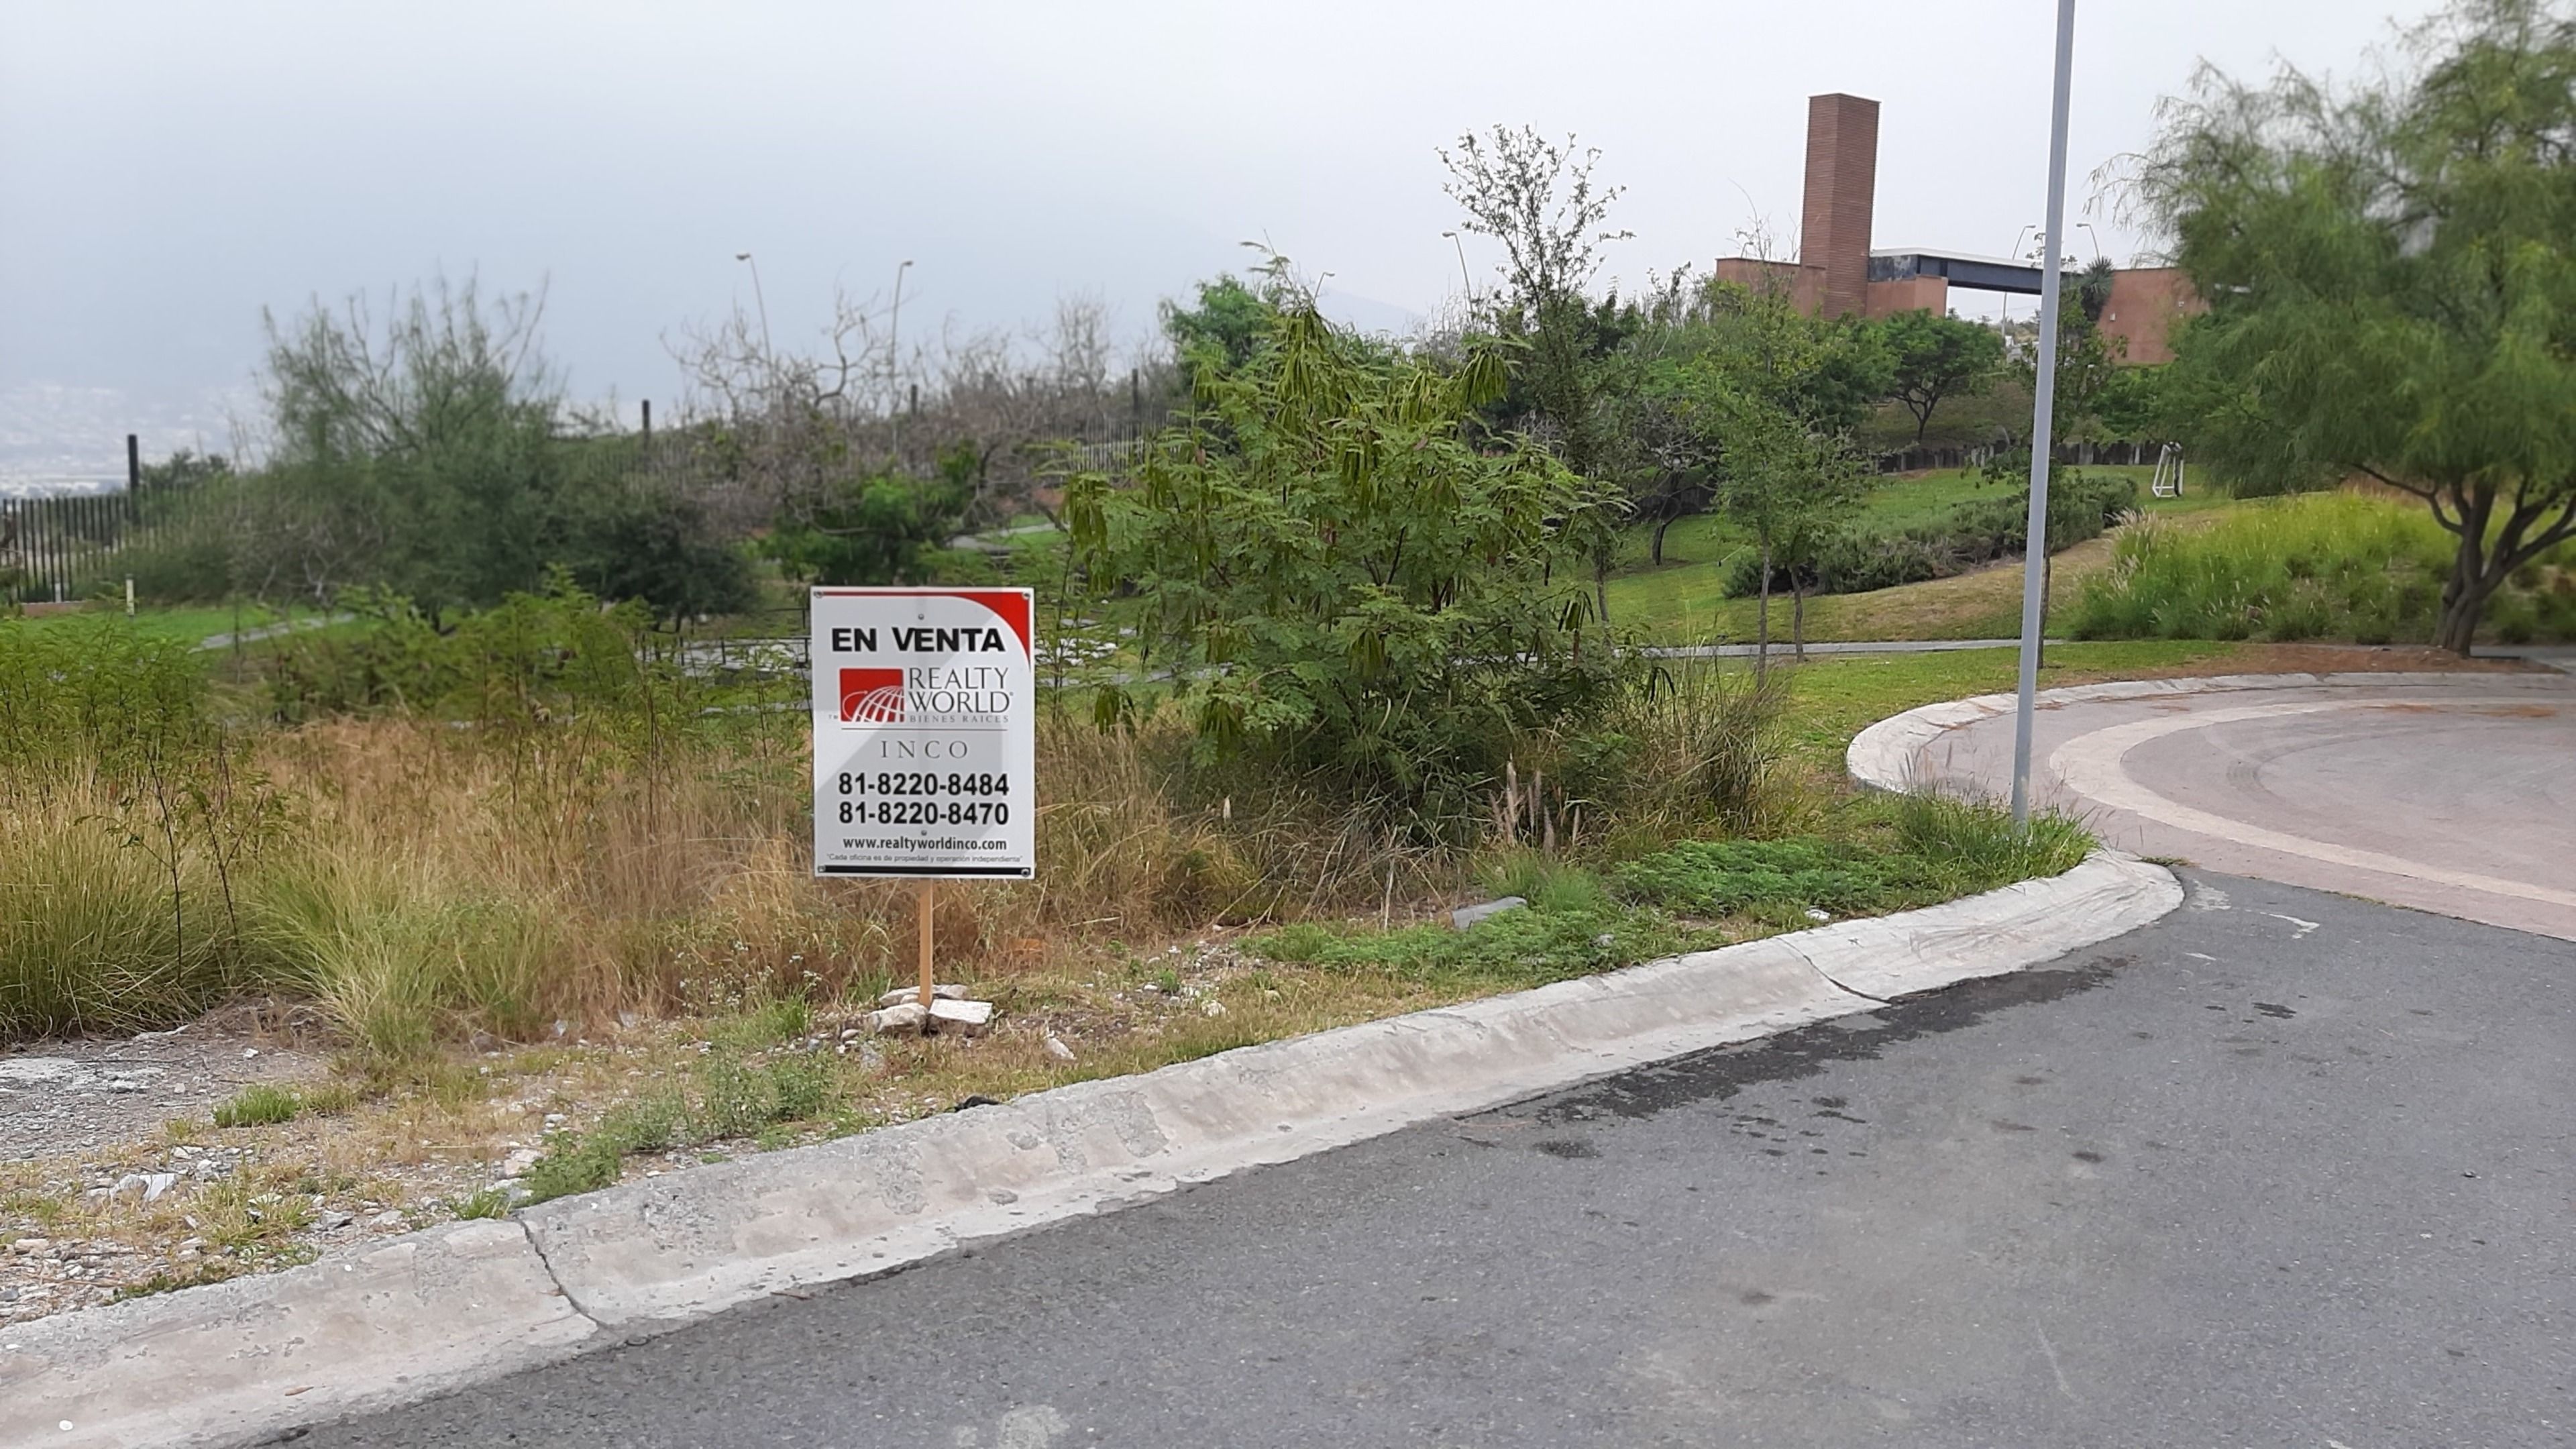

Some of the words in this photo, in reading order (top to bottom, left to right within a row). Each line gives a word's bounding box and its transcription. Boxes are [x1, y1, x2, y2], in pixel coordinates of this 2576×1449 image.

[832, 628, 877, 652] EN
[892, 627, 1006, 652] VENTA
[909, 667, 1009, 689] REALTY
[910, 714, 955, 723] BIENES
[881, 740, 968, 759] INCO
[839, 771, 1010, 796] 81-8220-8484
[839, 801, 1010, 825] 81-8220-8470
[843, 836, 1007, 853] www.realtyworldinco.com
